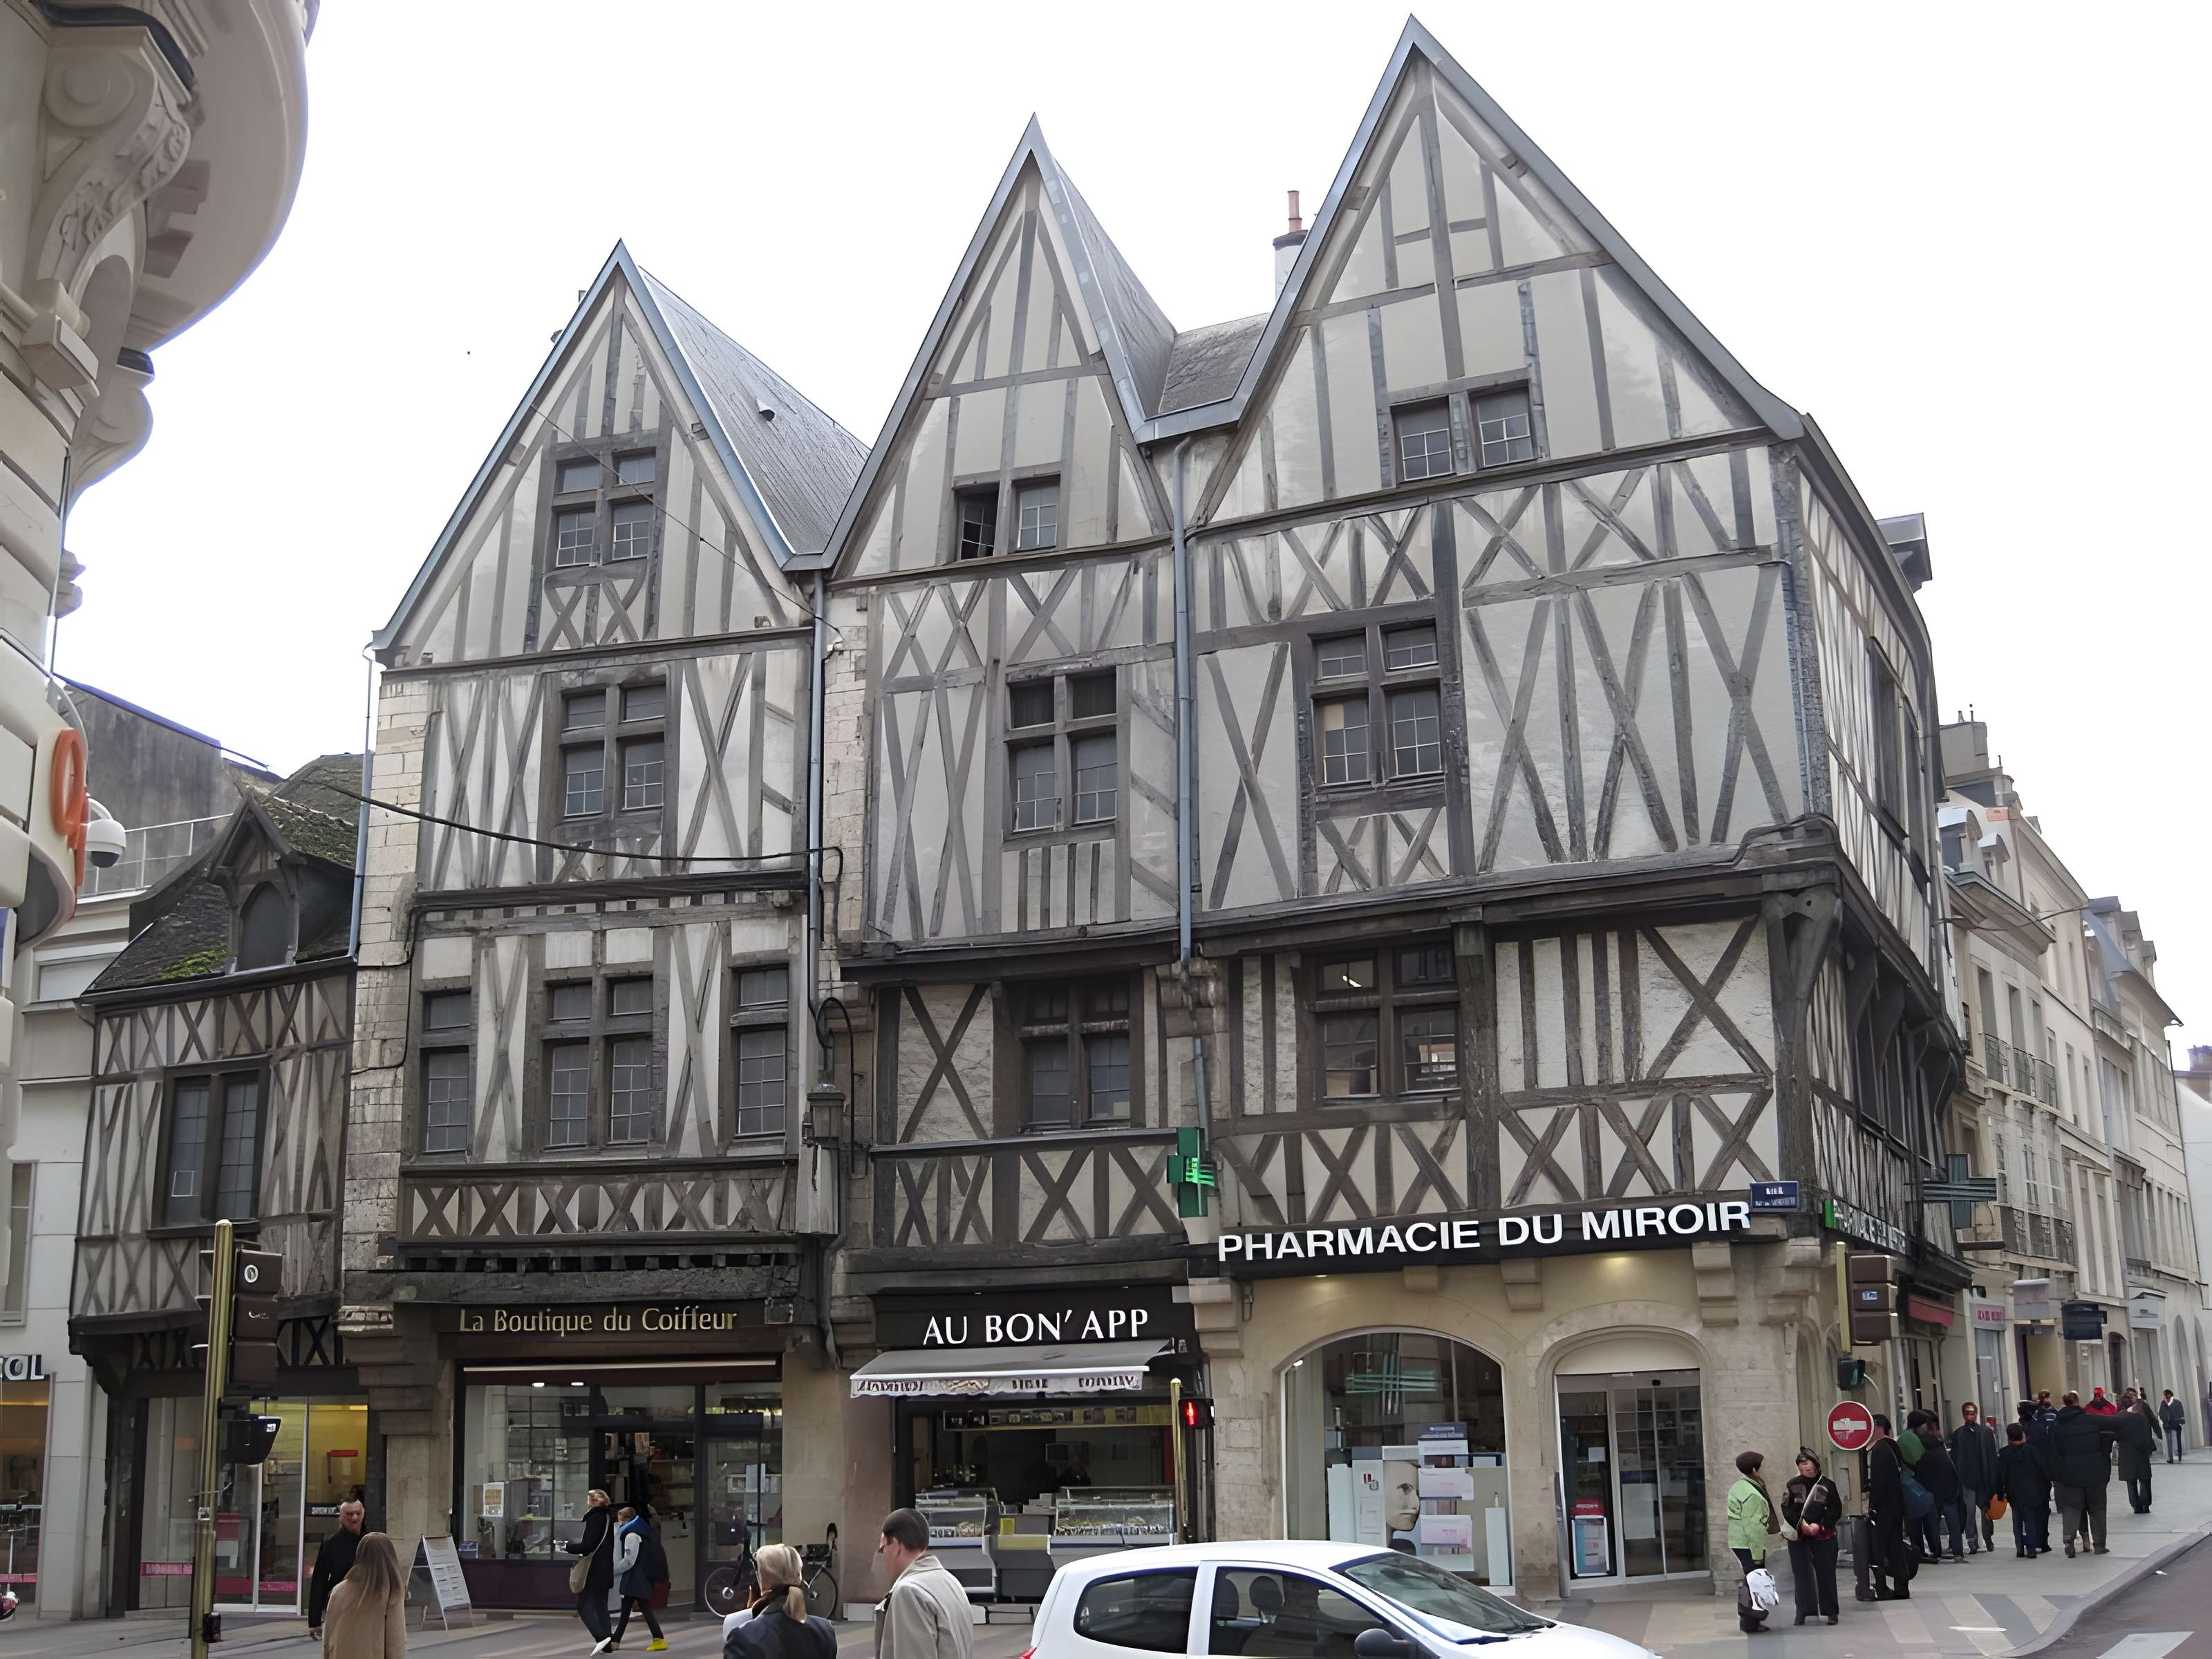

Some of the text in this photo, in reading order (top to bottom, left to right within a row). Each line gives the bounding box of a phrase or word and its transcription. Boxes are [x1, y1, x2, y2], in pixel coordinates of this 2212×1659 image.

[1218, 1200, 1752, 1262] PHARMACIE DU MIROIR
[459, 1304, 738, 1338] La Boutique du Coiffeur
[923, 1315, 968, 1346] AU
[1080, 1308, 1149, 1340] APP
[0, 1354, 45, 1381] OL
